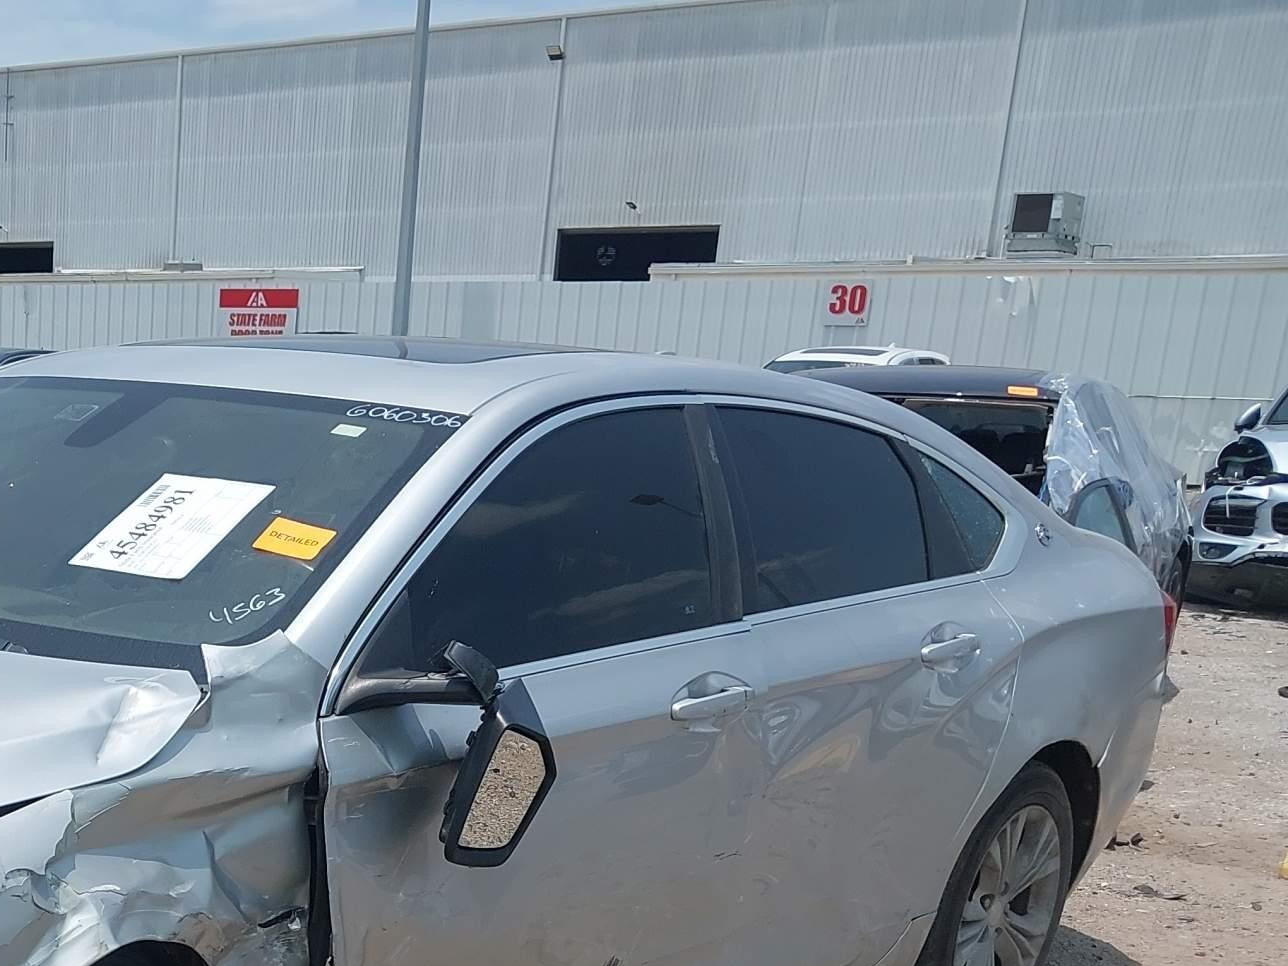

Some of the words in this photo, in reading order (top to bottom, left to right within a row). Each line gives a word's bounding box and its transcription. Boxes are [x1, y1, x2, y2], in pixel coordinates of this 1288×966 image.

[829, 285, 867, 314] 30
[228, 312, 258, 328] STATE
[258, 312, 288, 329] FARM
[345, 403, 463, 428] 6060306
[110, 488, 196, 560] 45484981
[269, 529, 320, 547] DETAILED
[208, 587, 287, 625] 4563
